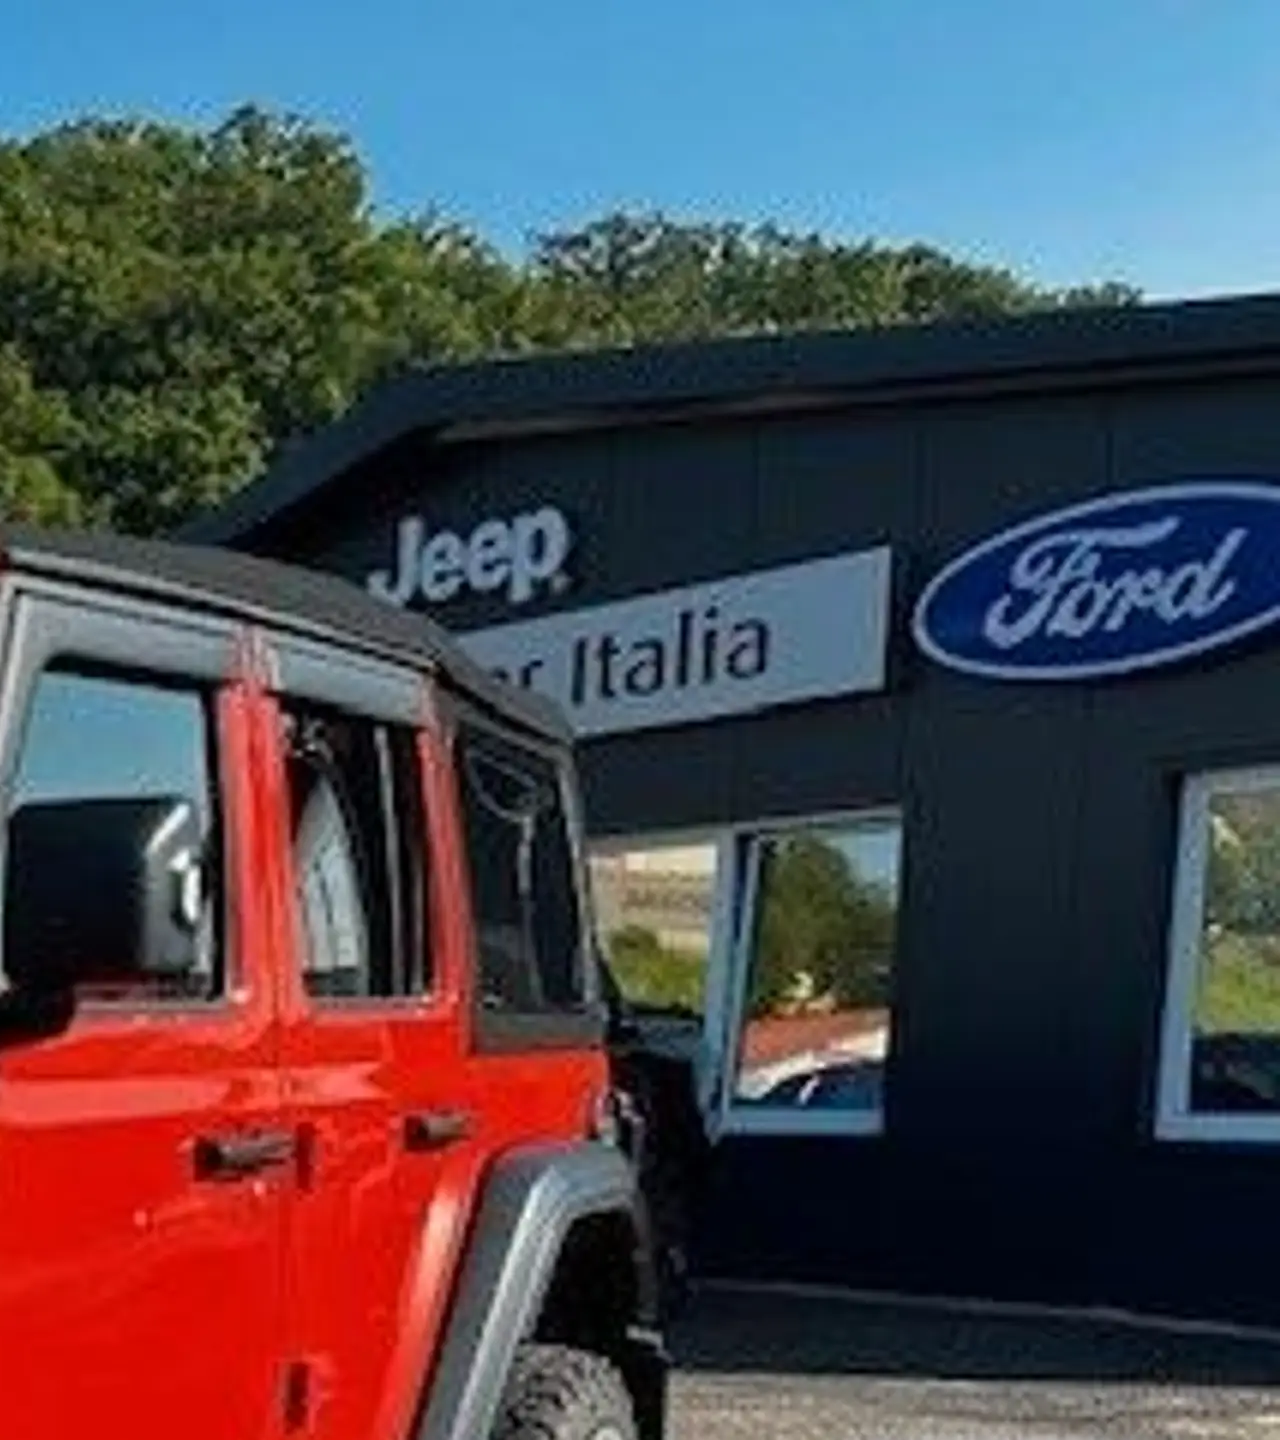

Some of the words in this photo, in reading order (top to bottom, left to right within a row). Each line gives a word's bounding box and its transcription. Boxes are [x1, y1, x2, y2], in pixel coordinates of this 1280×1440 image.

[367, 506, 570, 604] Jeep
[984, 515, 1248, 650] Ford
[571, 606, 770, 705] Italia
